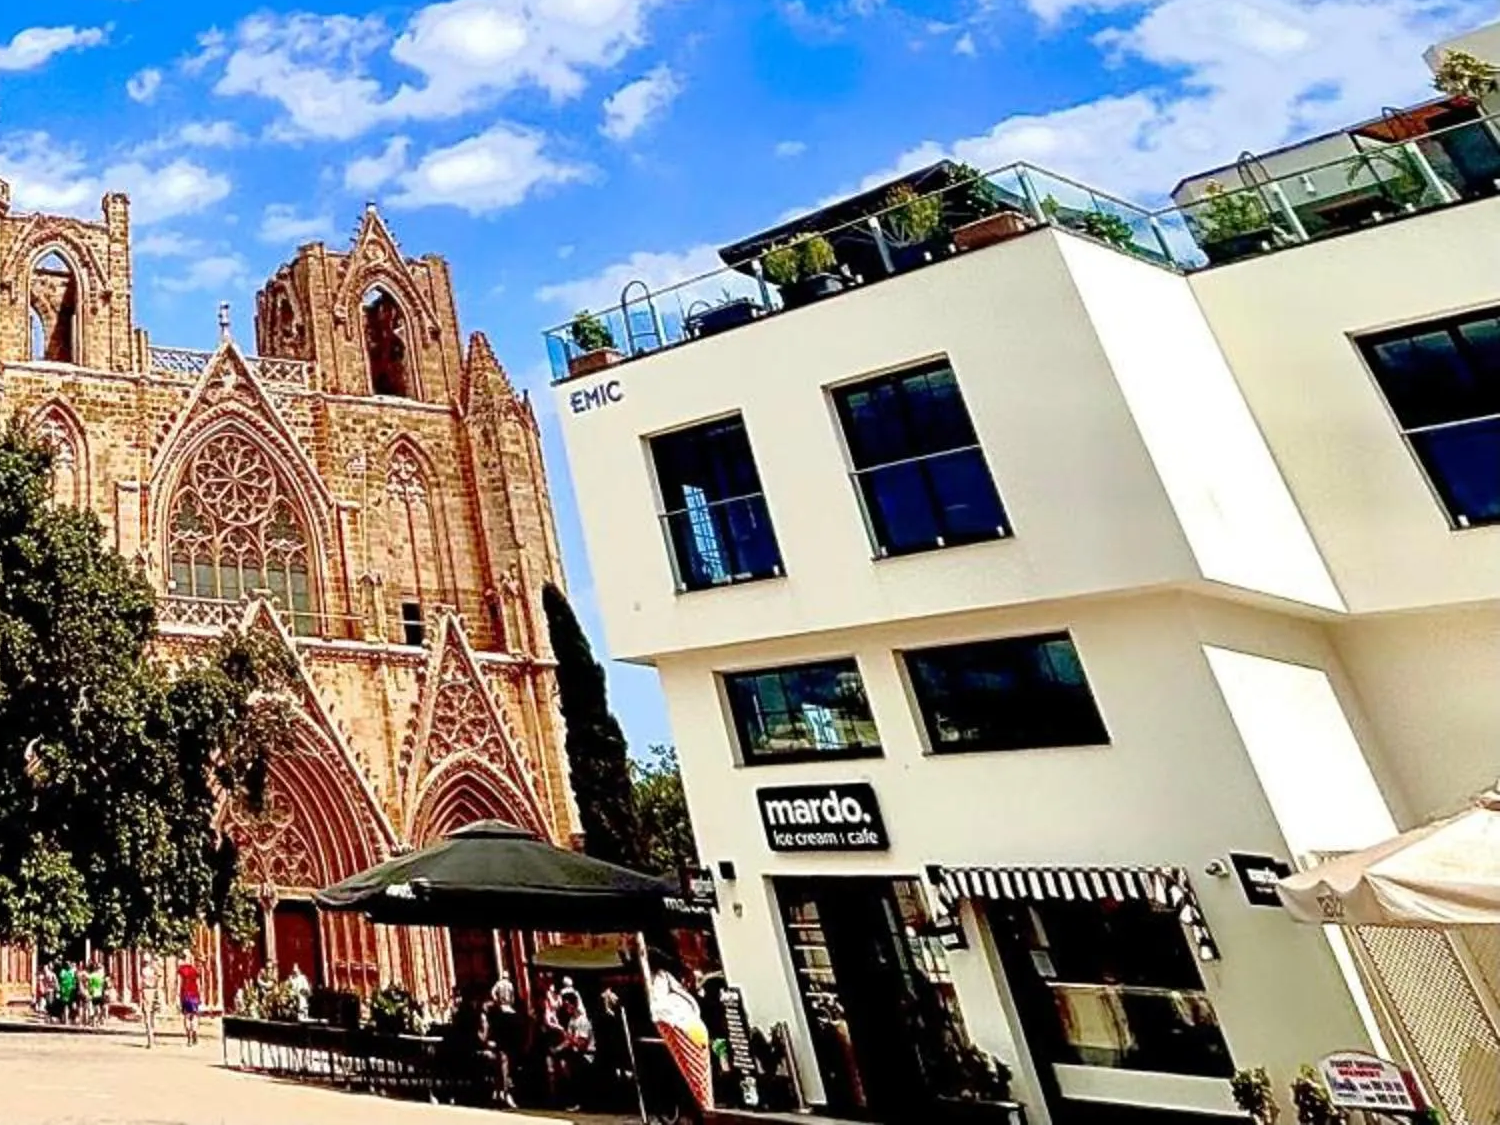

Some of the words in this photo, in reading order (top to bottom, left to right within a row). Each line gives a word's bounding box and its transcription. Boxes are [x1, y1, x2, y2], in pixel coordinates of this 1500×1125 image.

[570, 380, 624, 414] EMIC
[765, 789, 872, 825] mardo.
[795, 831, 839, 846] cream
